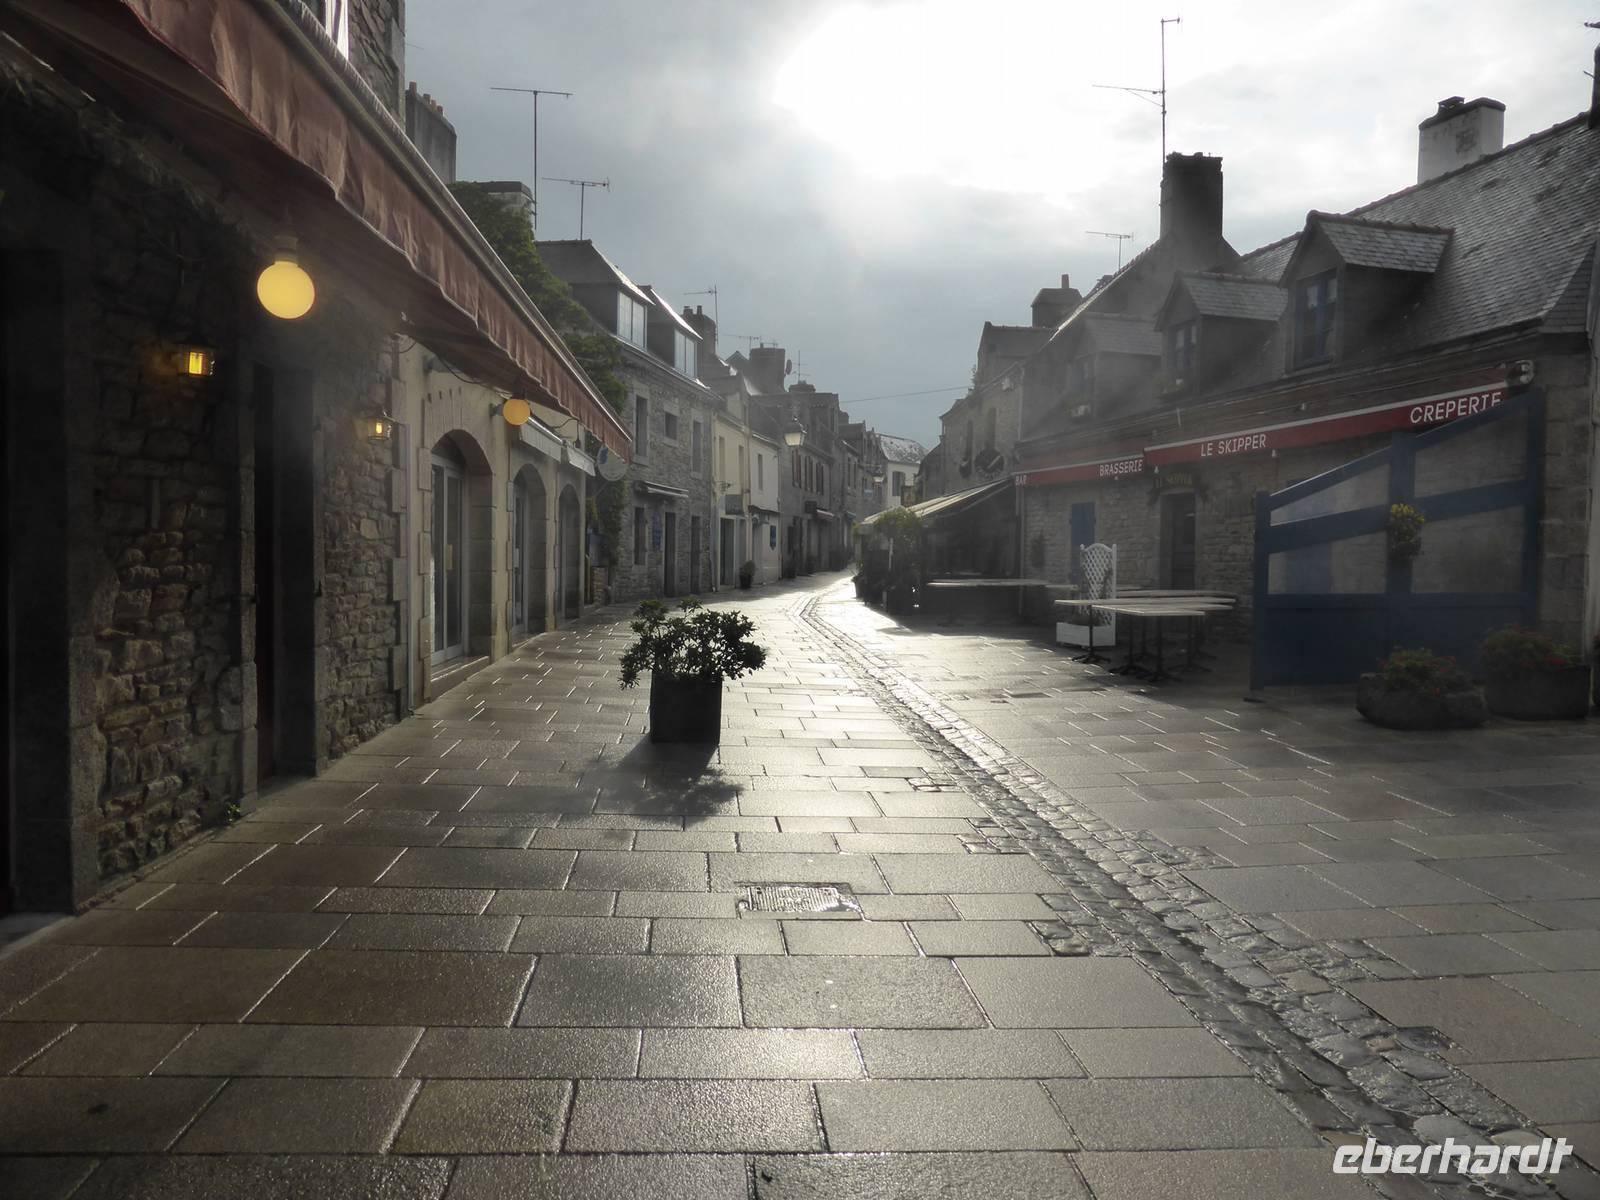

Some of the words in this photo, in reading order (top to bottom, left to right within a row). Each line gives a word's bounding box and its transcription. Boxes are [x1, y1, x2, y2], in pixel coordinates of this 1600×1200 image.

[1410, 391, 1502, 424] CREPERIE
[1200, 442, 1214, 457] LE
[1217, 433, 1267, 455] SKIPPER
[1099, 459, 1144, 477] BRASSERIE
[1015, 474, 1028, 486] BAR
